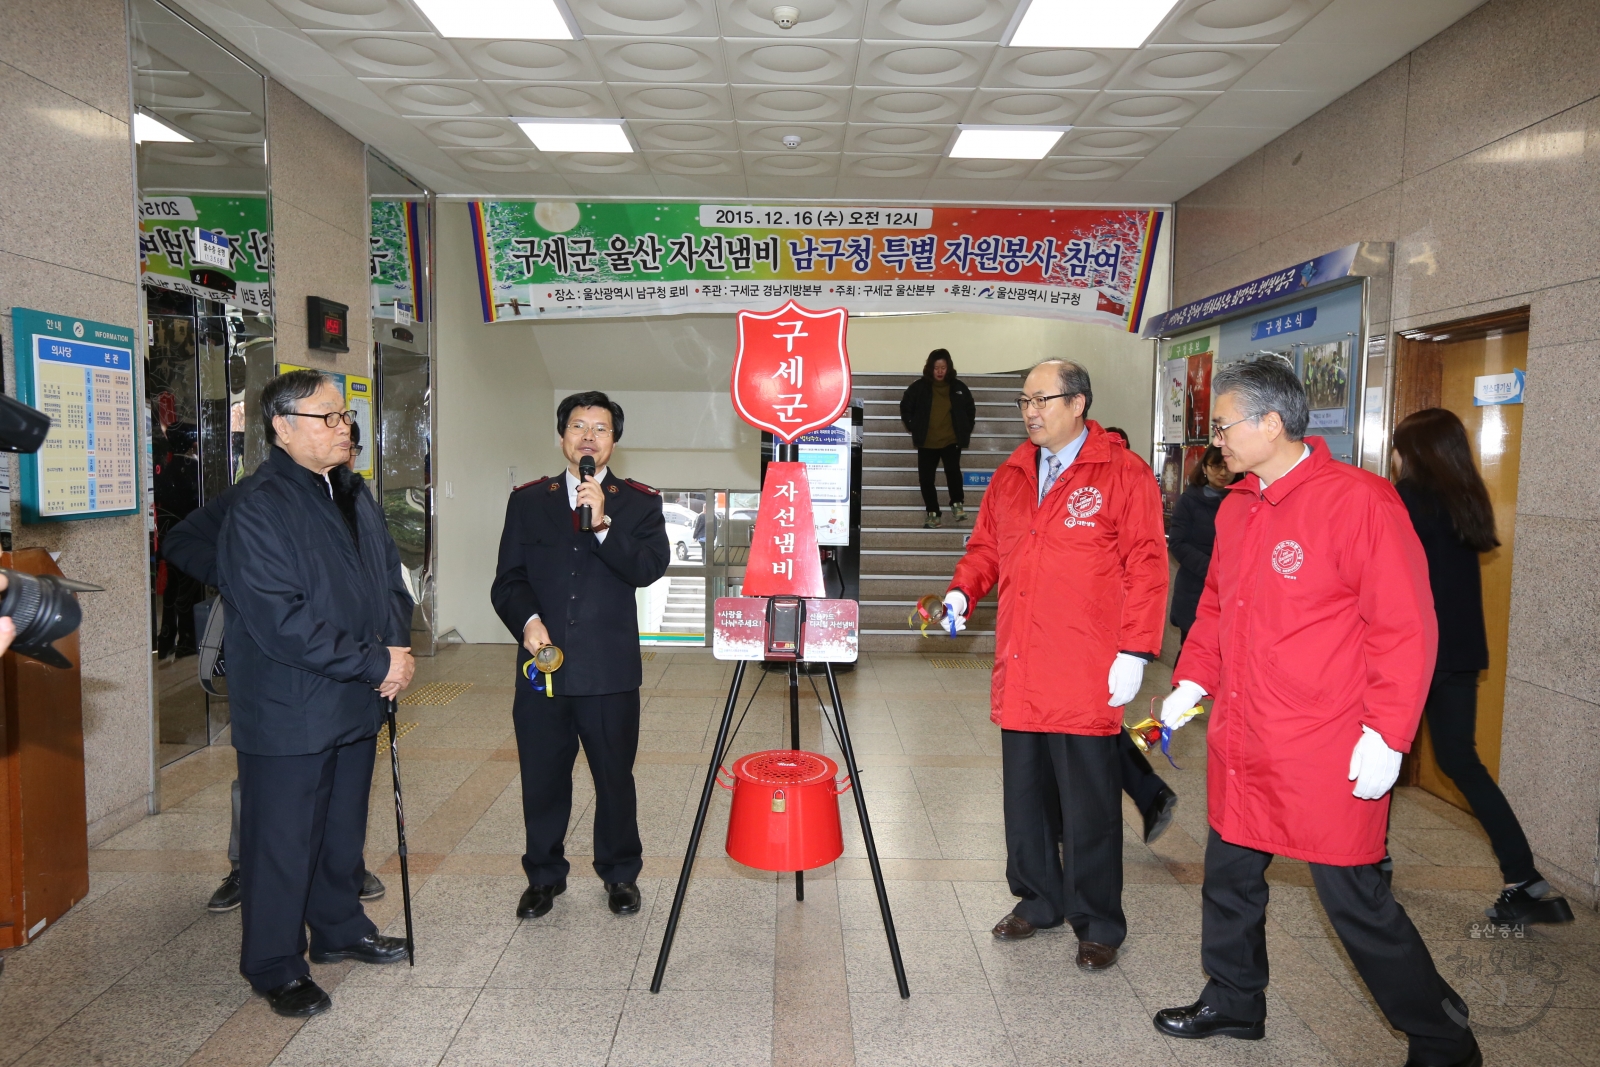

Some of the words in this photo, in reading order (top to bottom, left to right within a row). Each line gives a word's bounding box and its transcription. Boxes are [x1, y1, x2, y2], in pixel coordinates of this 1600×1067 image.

[817, 211, 844, 227] (수)
[849, 211, 879, 226] 오전
[885, 212, 918, 227] 12시
[512, 237, 597, 275] 구세군
[604, 235, 663, 272] 울산
[669, 235, 779, 272] 자선냄비
[788, 237, 871, 273] 남구청
[880, 236, 937, 272] 특별
[942, 237, 1055, 276] 자원봉사
[1064, 240, 1121, 282] 참여
[729, 285, 760, 297] 구세군
[763, 285, 822, 297] 경남지방본부
[863, 285, 893, 297] 구세군
[896, 285, 935, 297] 울산본부
[1257, 269, 1296, 298] 행복남구
[582, 288, 633, 301] 울산광역시
[636, 287, 667, 300] 남구청
[670, 286, 688, 299] 로비
[997, 288, 1047, 302] 울산광역시
[1050, 291, 1081, 306] 남구청
[46, 319, 62, 332] 안내
[1265, 312, 1303, 335] 구정소식
[94, 330, 129, 342] INFORMATION
[51, 345, 72, 358] 의사당
[772, 321, 808, 423] 구세군
[1482, 382, 1512, 395] 청소대기실
[772, 481, 799, 580] 자선냄비
[721, 611, 743, 619] 사랑을
